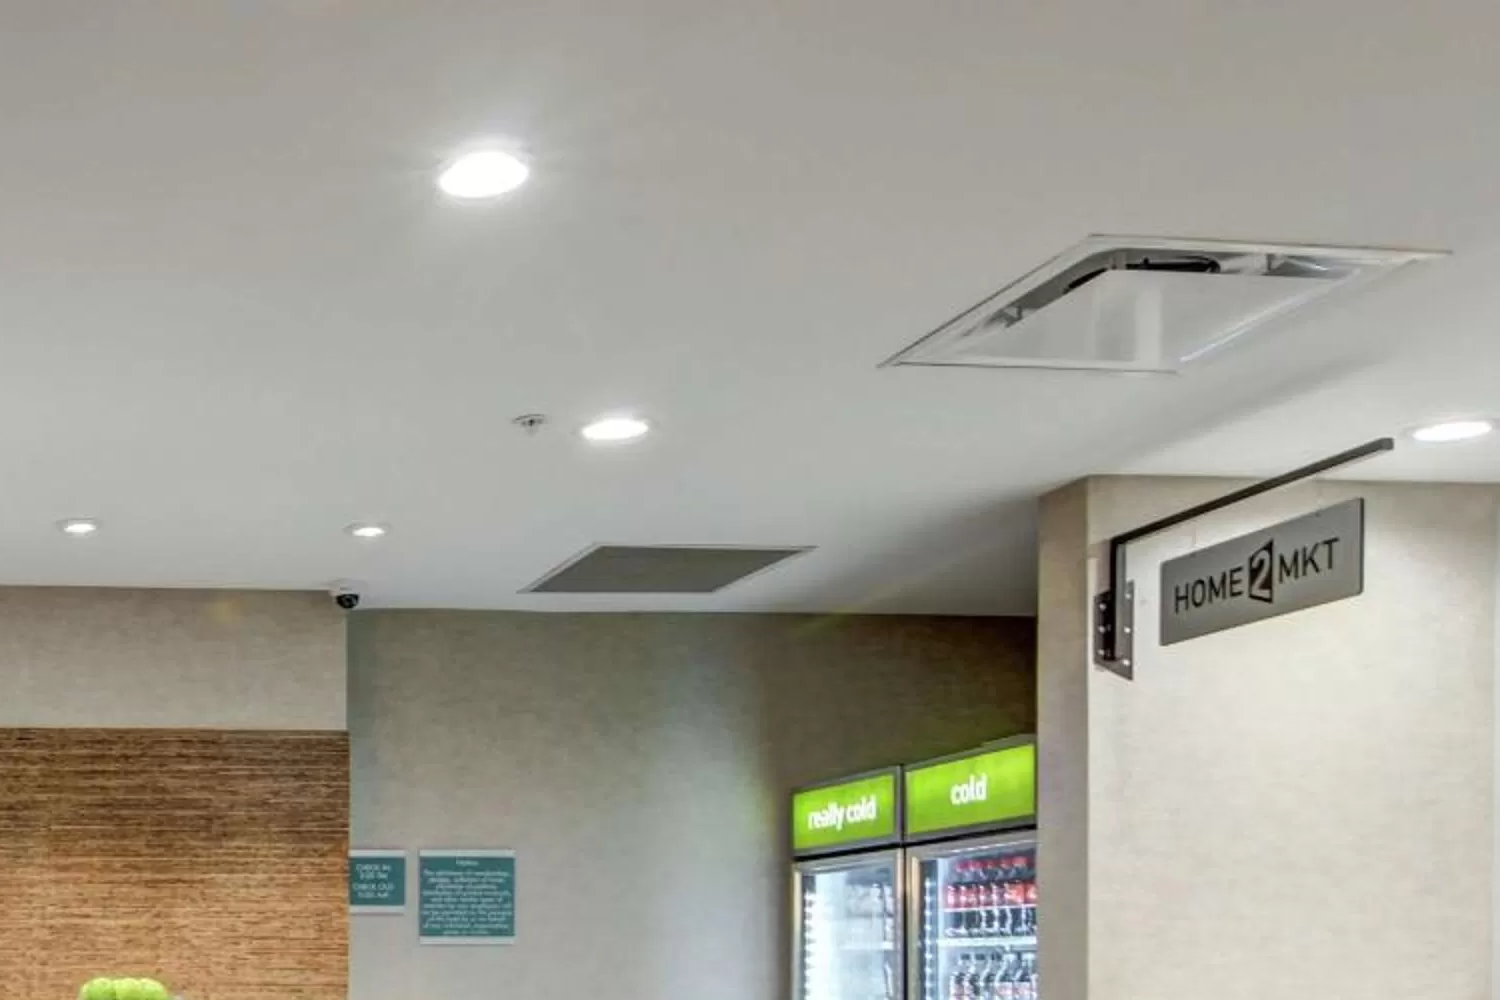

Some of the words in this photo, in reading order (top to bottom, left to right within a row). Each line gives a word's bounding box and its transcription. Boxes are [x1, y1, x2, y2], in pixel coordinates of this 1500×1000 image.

[1279, 537, 1340, 584] MKT
[950, 773, 987, 805] cold
[808, 802, 844, 831] really
[846, 795, 877, 823] cold
